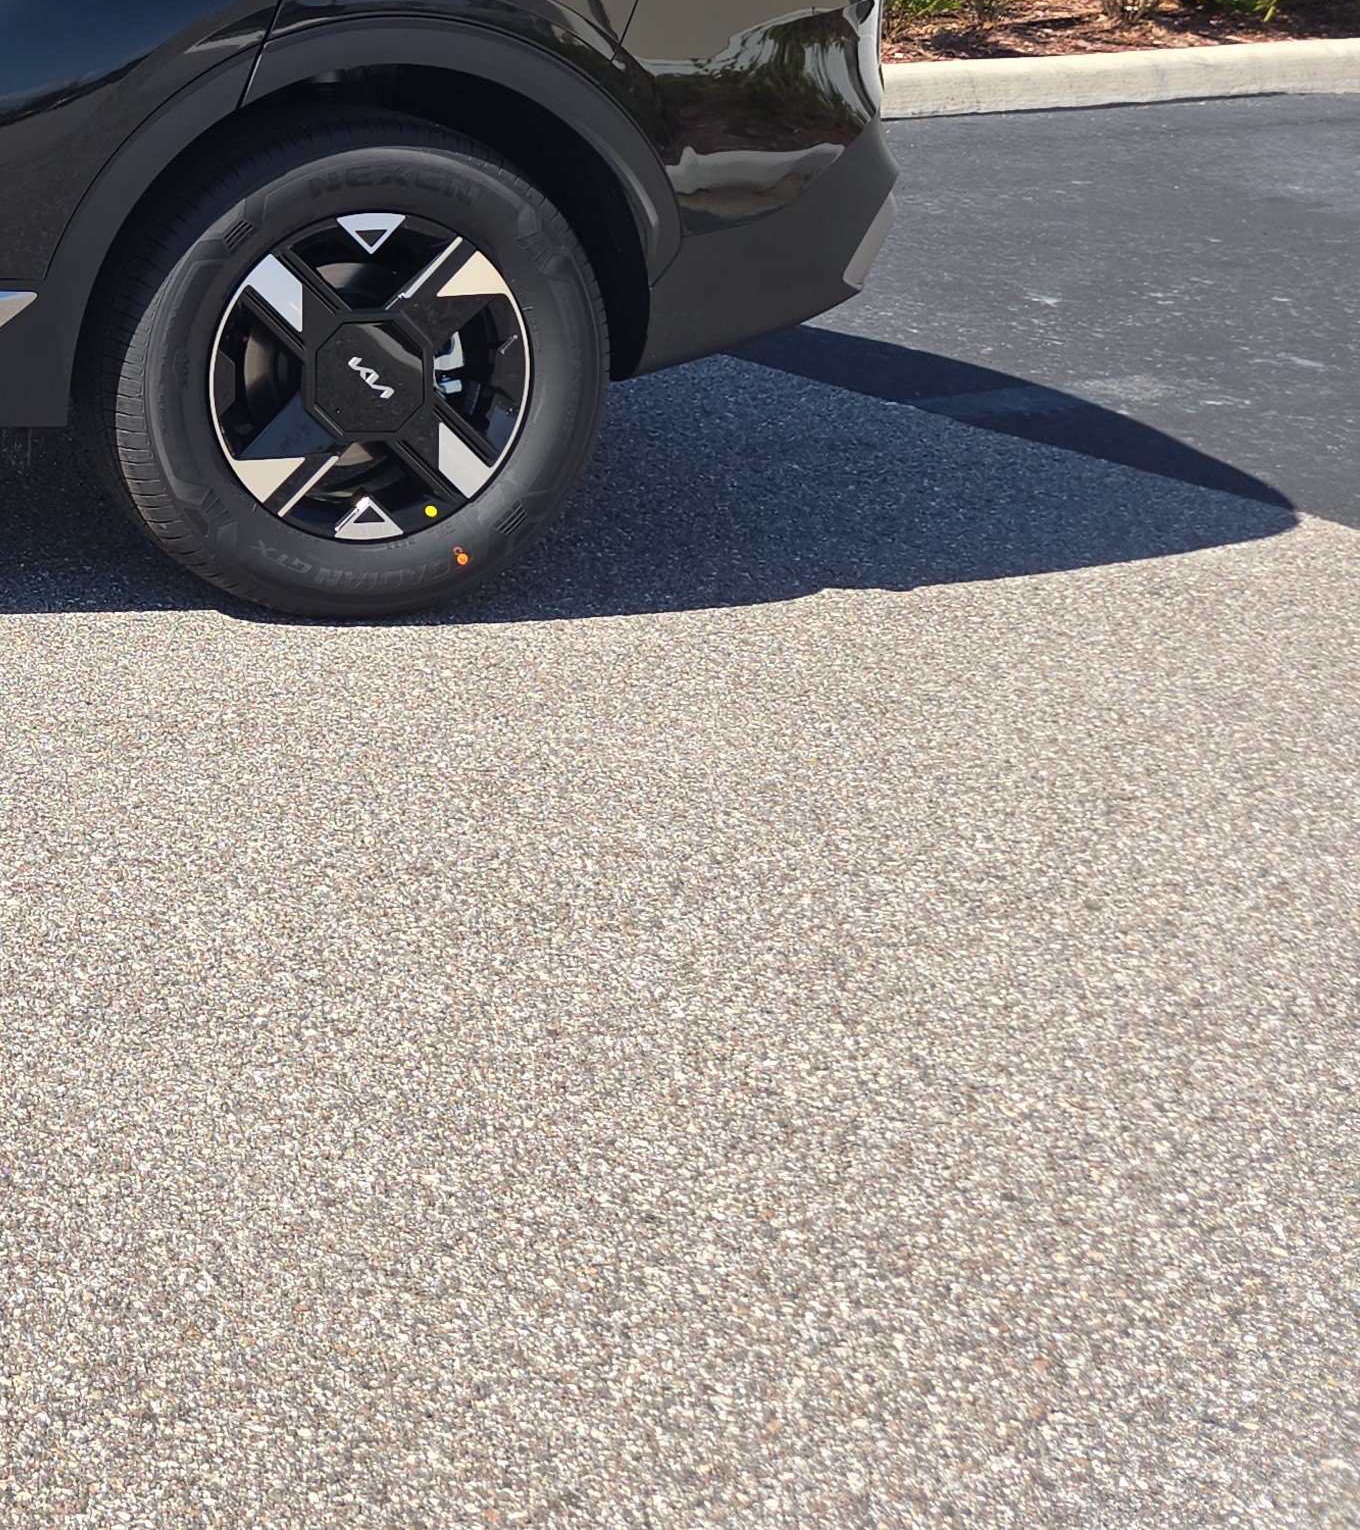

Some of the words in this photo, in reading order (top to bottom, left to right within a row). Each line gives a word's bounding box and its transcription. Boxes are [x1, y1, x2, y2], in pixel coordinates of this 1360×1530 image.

[307, 163, 480, 205] NEXEN
[348, 357, 394, 399] KIA
[250, 539, 313, 577] GTX
